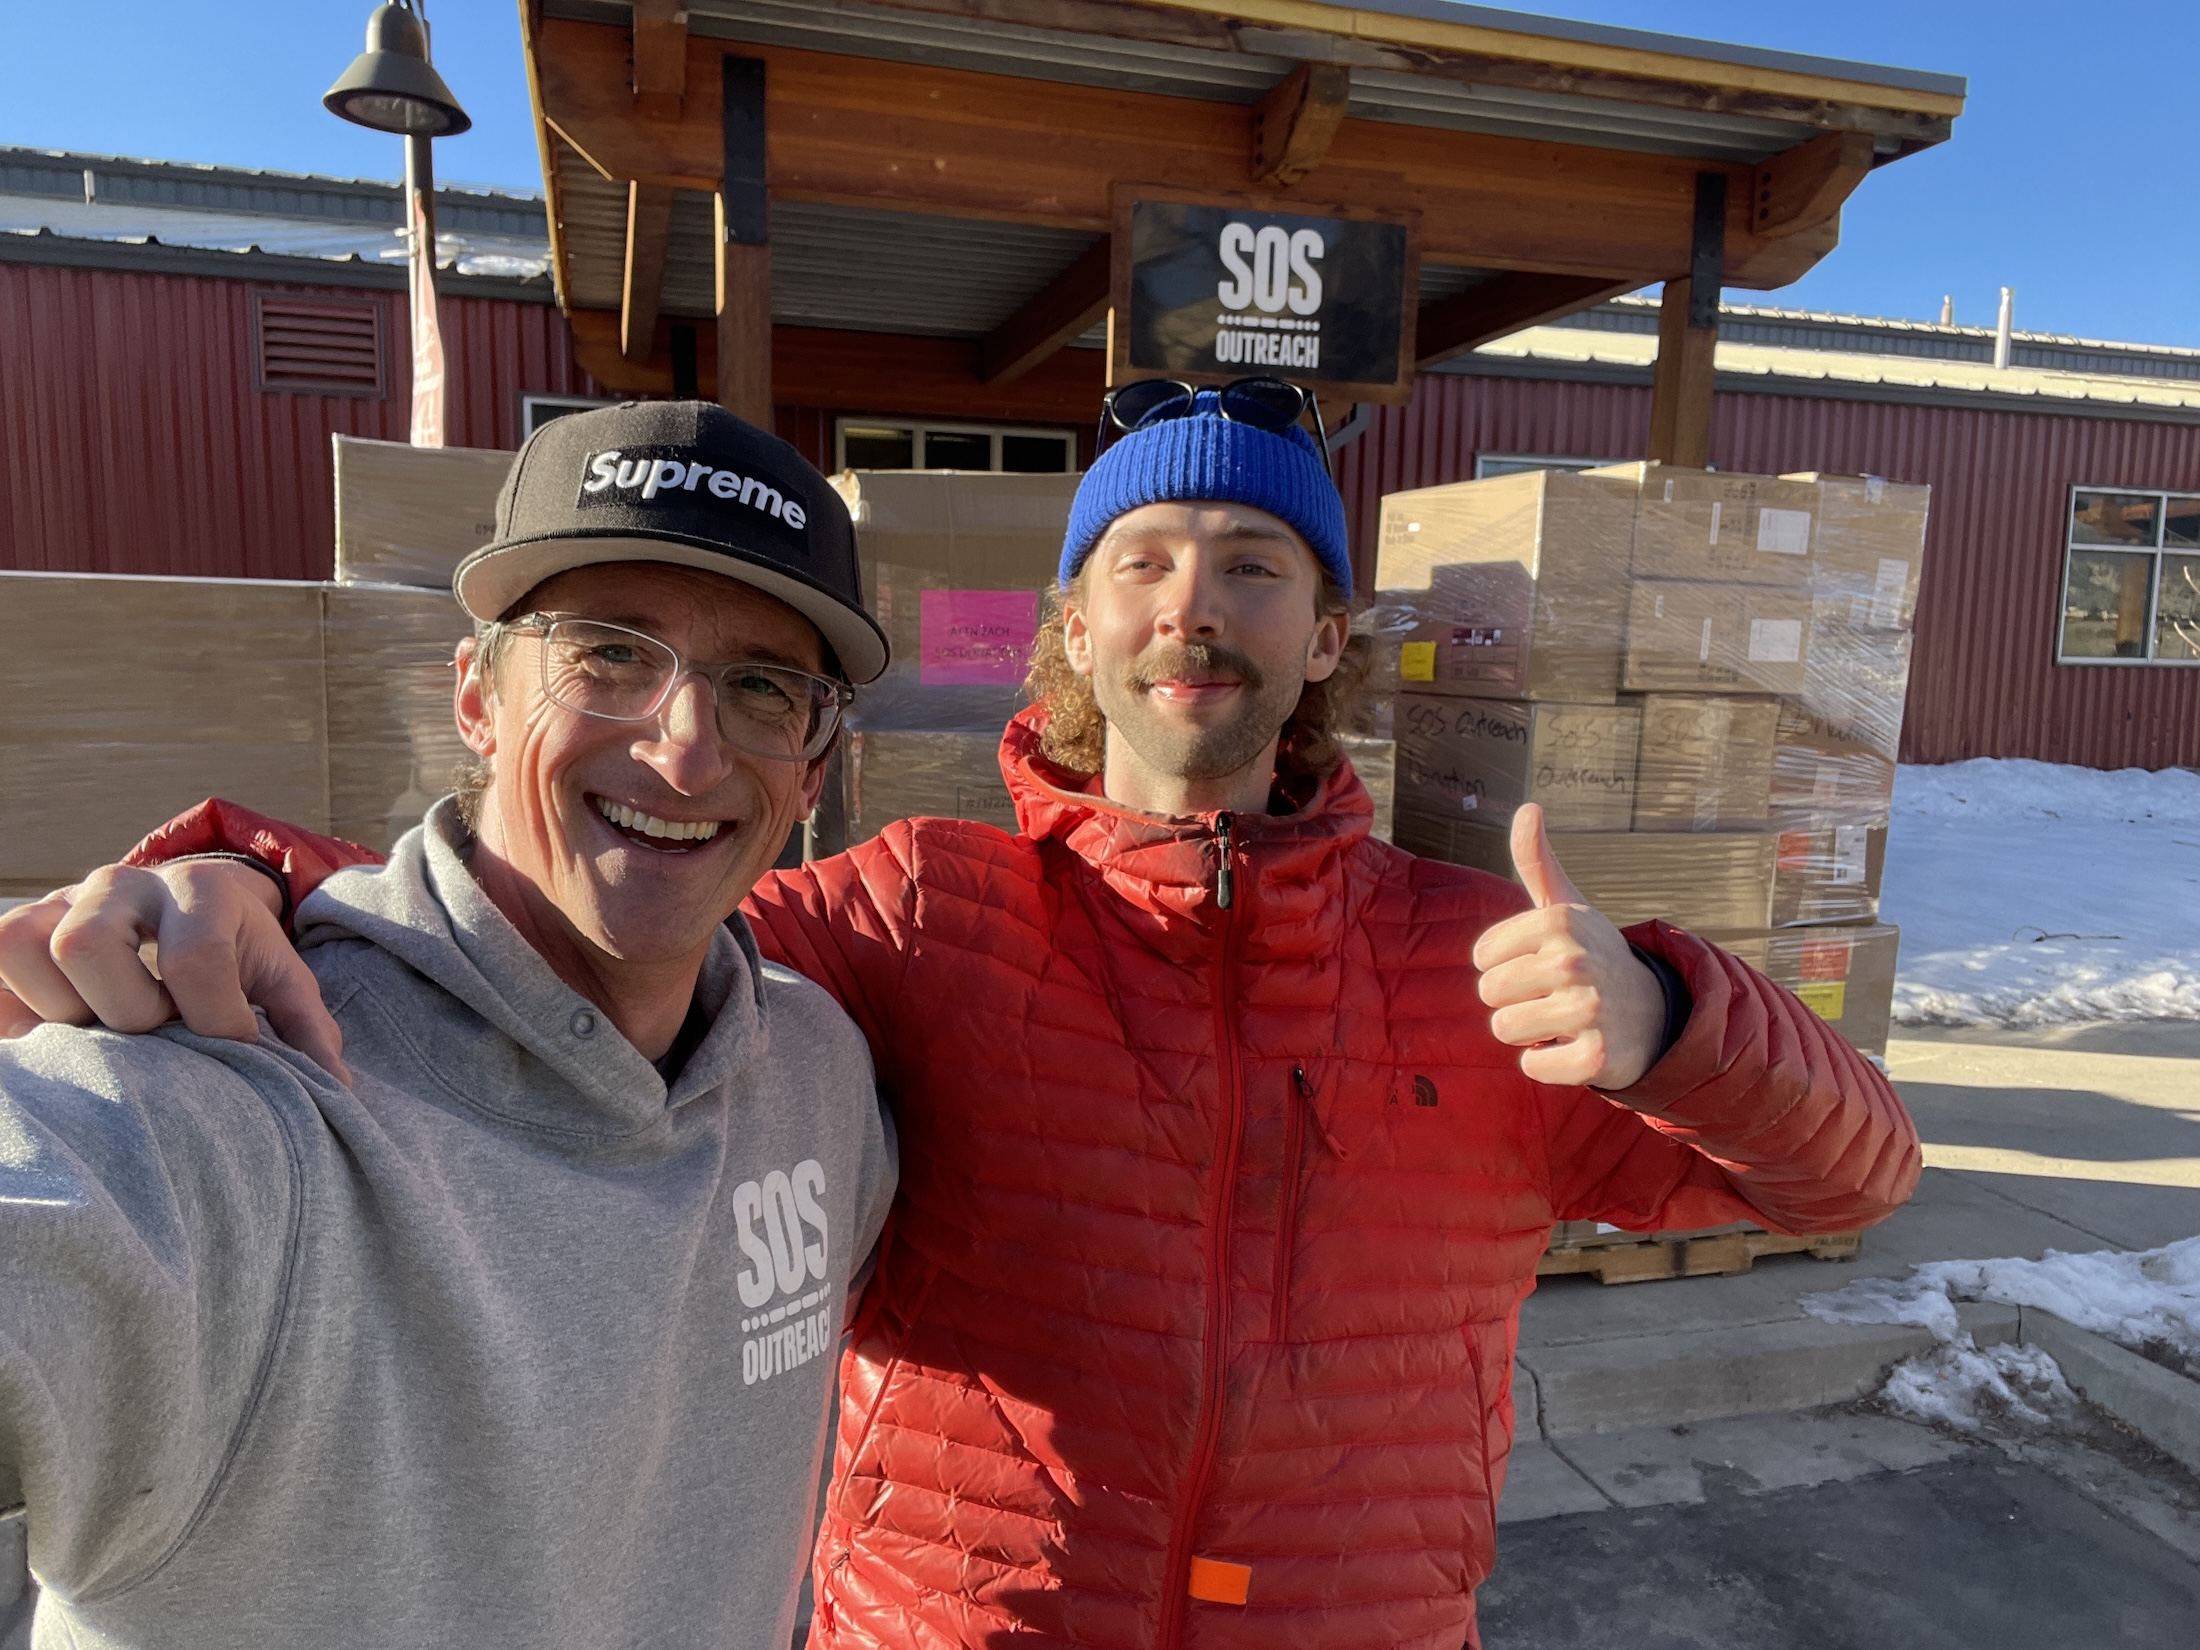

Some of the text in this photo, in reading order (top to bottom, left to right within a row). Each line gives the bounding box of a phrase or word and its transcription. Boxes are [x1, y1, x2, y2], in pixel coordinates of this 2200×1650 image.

[1218, 222, 1324, 315] SOS
[1216, 330, 1320, 368] OUTREACH
[584, 451, 806, 530] Supreme
[1407, 704, 1446, 736] SOS
[733, 1159, 828, 1308] SOS
[742, 1303, 831, 1386] OUTREAC
